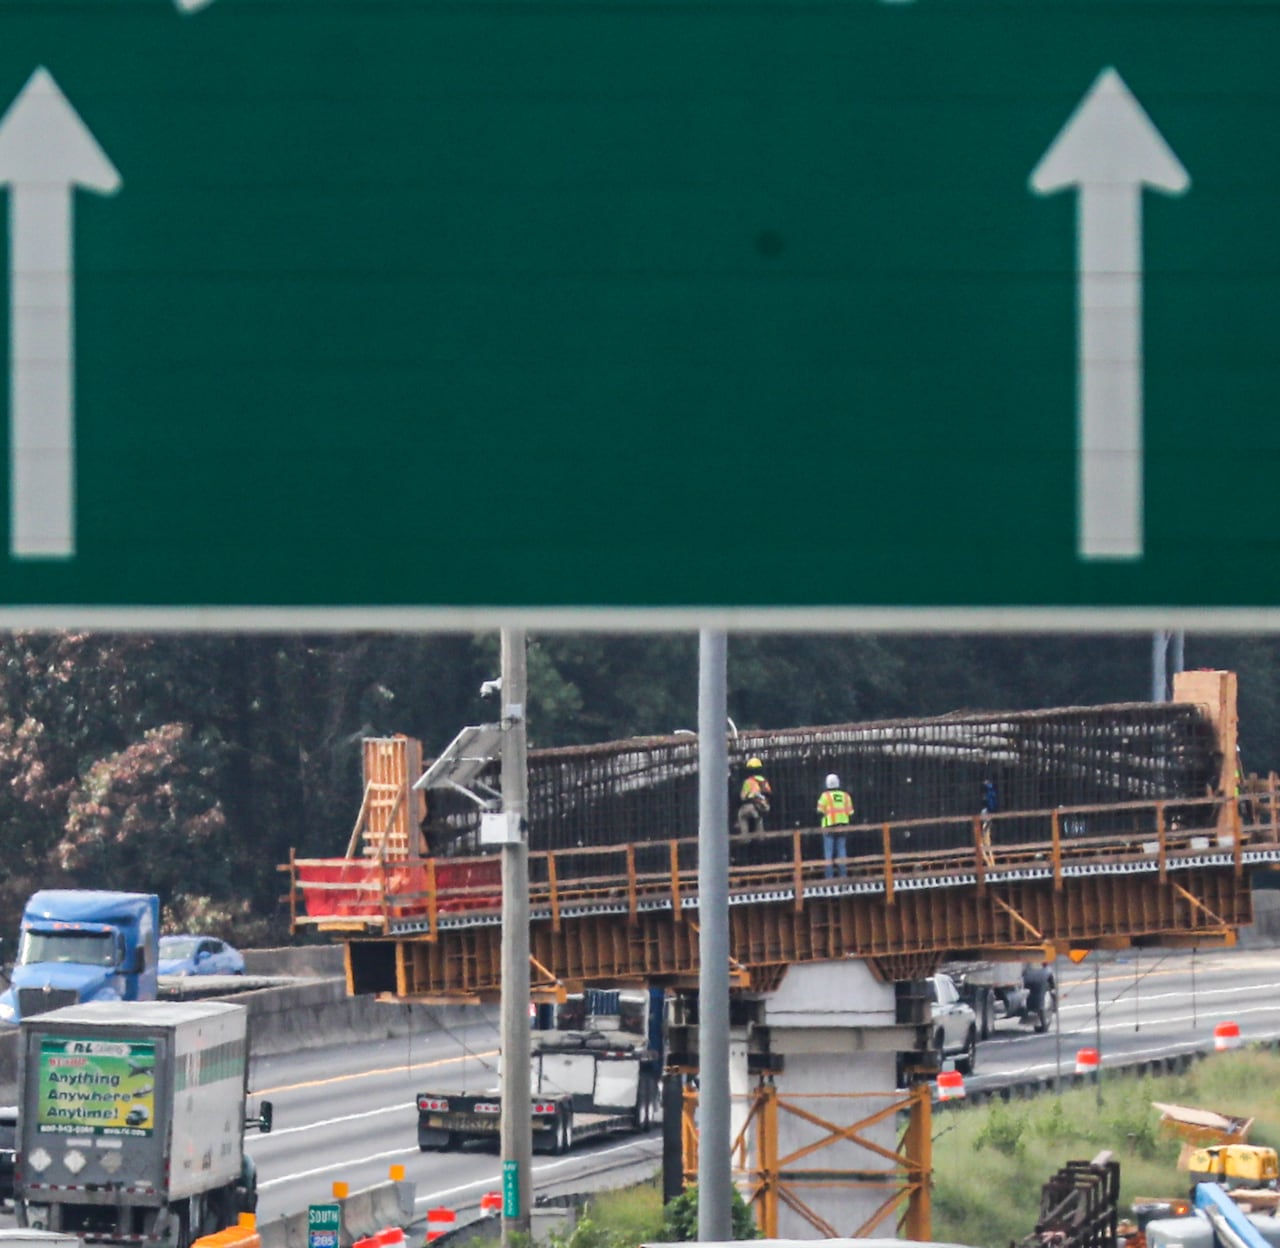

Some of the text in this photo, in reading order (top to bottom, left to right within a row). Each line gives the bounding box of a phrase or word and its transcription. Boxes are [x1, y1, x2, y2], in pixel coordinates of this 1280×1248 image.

[48, 1071, 120, 1087] Anything
[48, 1089, 131, 1101] Anywhere
[47, 1107, 118, 1119] Anytime!
[310, 1209, 338, 1223] SOUTH
[313, 1236, 334, 1247] 285
